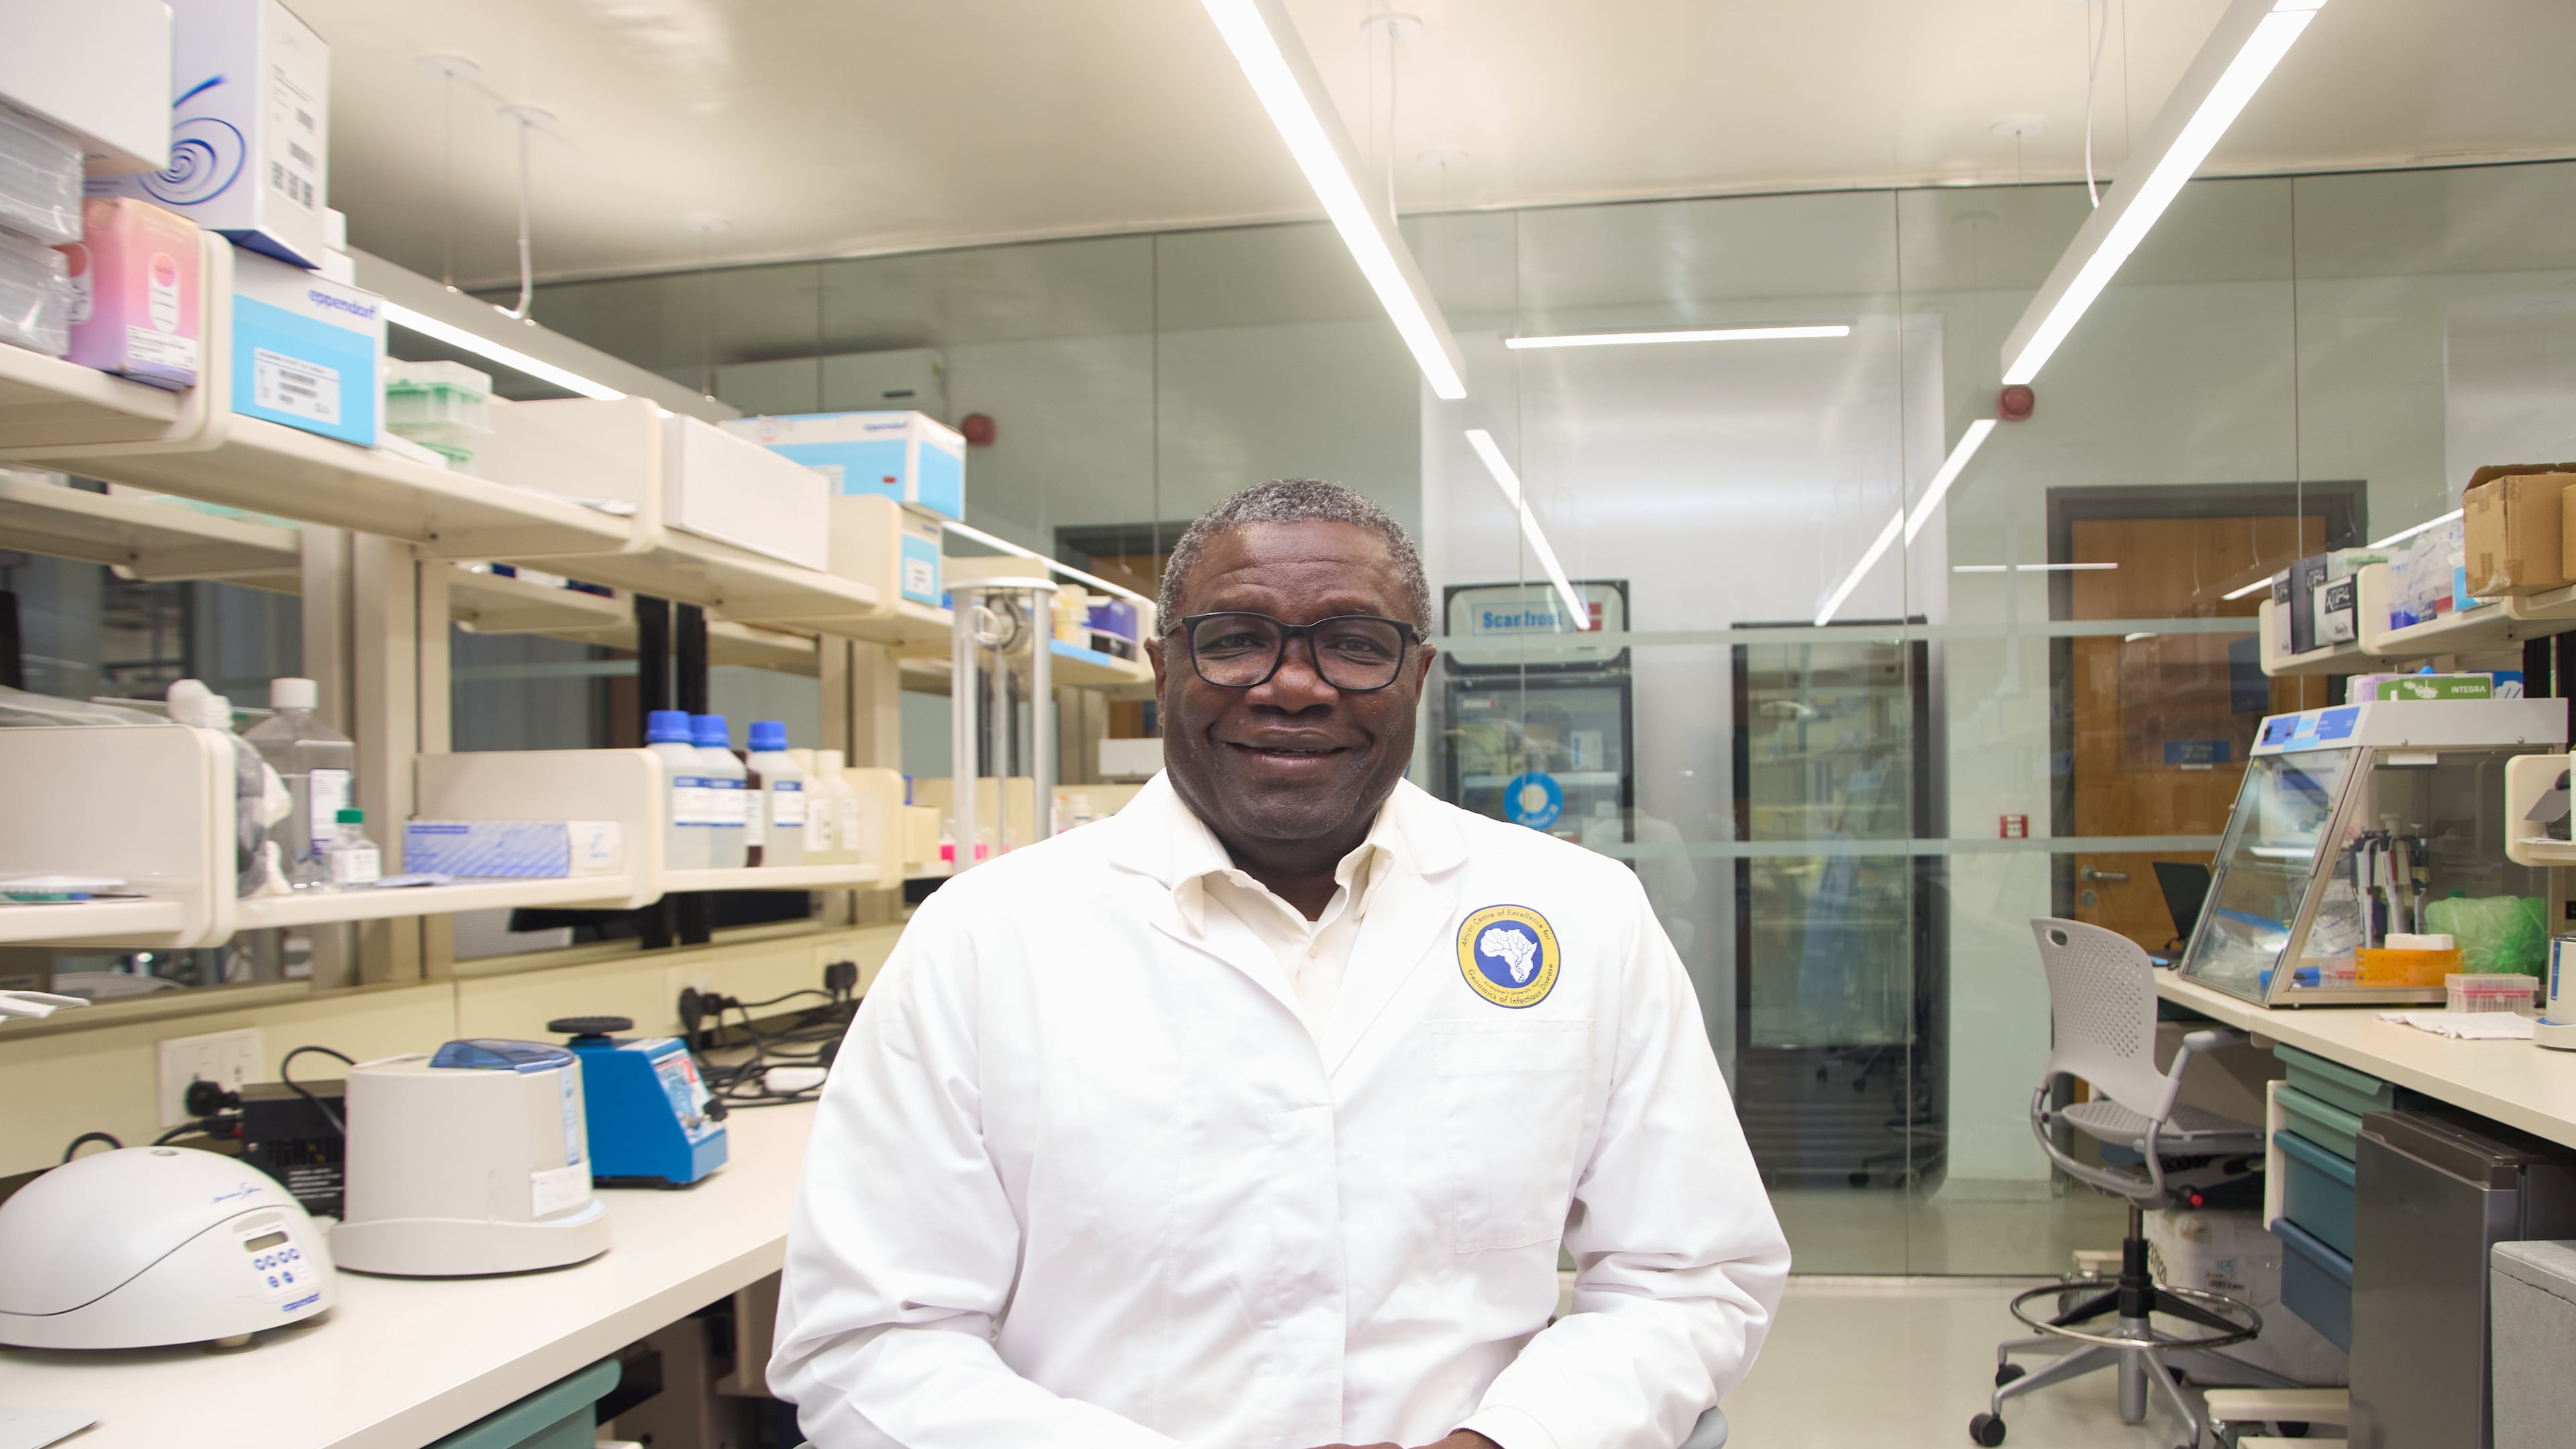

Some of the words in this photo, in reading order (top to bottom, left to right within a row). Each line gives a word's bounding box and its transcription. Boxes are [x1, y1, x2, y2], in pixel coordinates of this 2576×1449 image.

[309, 289, 375, 320] eppendorf
[2451, 685, 2486, 694] INTEGRA
[1461, 924, 1474, 947] African
[1473, 914, 1495, 925] Centre
[1507, 910, 1544, 928] Excellence
[1543, 929, 1551, 941] for
[1468, 969, 1497, 1000] Genomics
[1510, 990, 1542, 1004] Infectious
[1540, 963, 1554, 991] Disease
